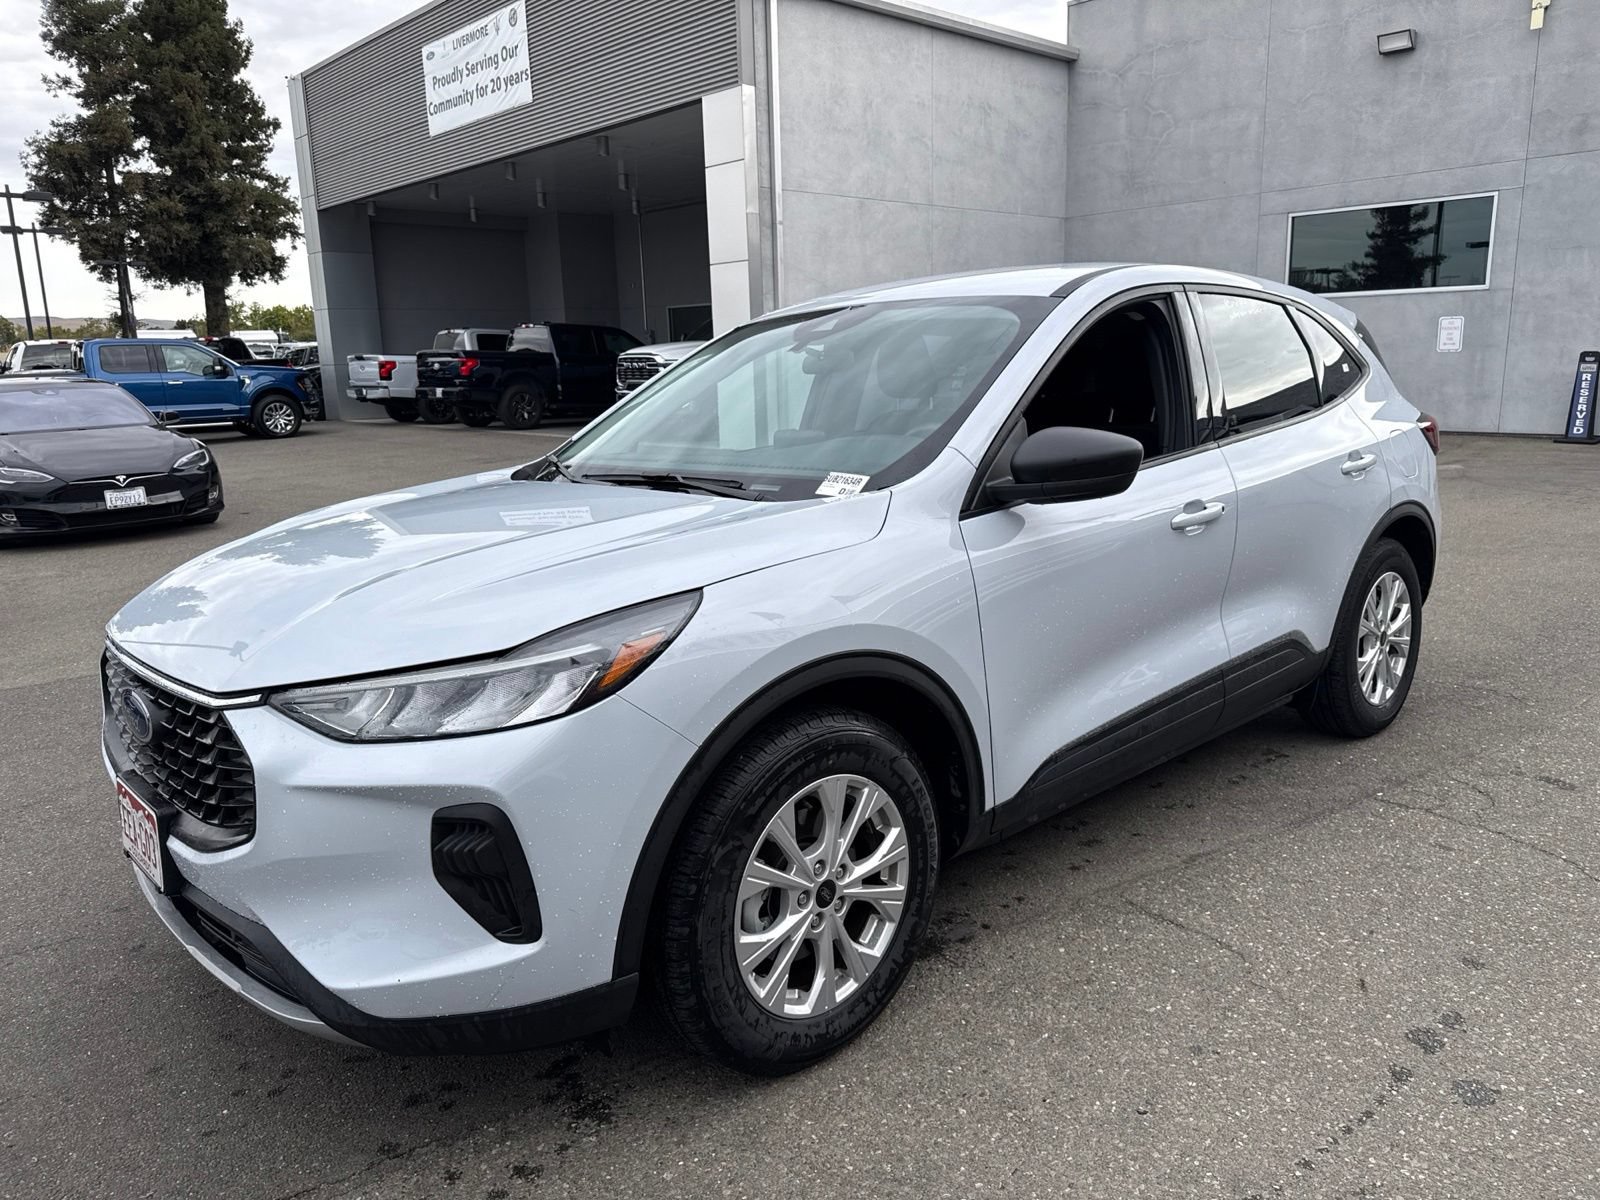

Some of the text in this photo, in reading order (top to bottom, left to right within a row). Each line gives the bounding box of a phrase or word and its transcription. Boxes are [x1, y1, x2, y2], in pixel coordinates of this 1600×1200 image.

[452, 24, 488, 50] LIVERMORE
[432, 44, 519, 90] Proudly Serving Our
[428, 68, 530, 116] Community for 20 years
[1573, 373, 1592, 434] RESERVED
